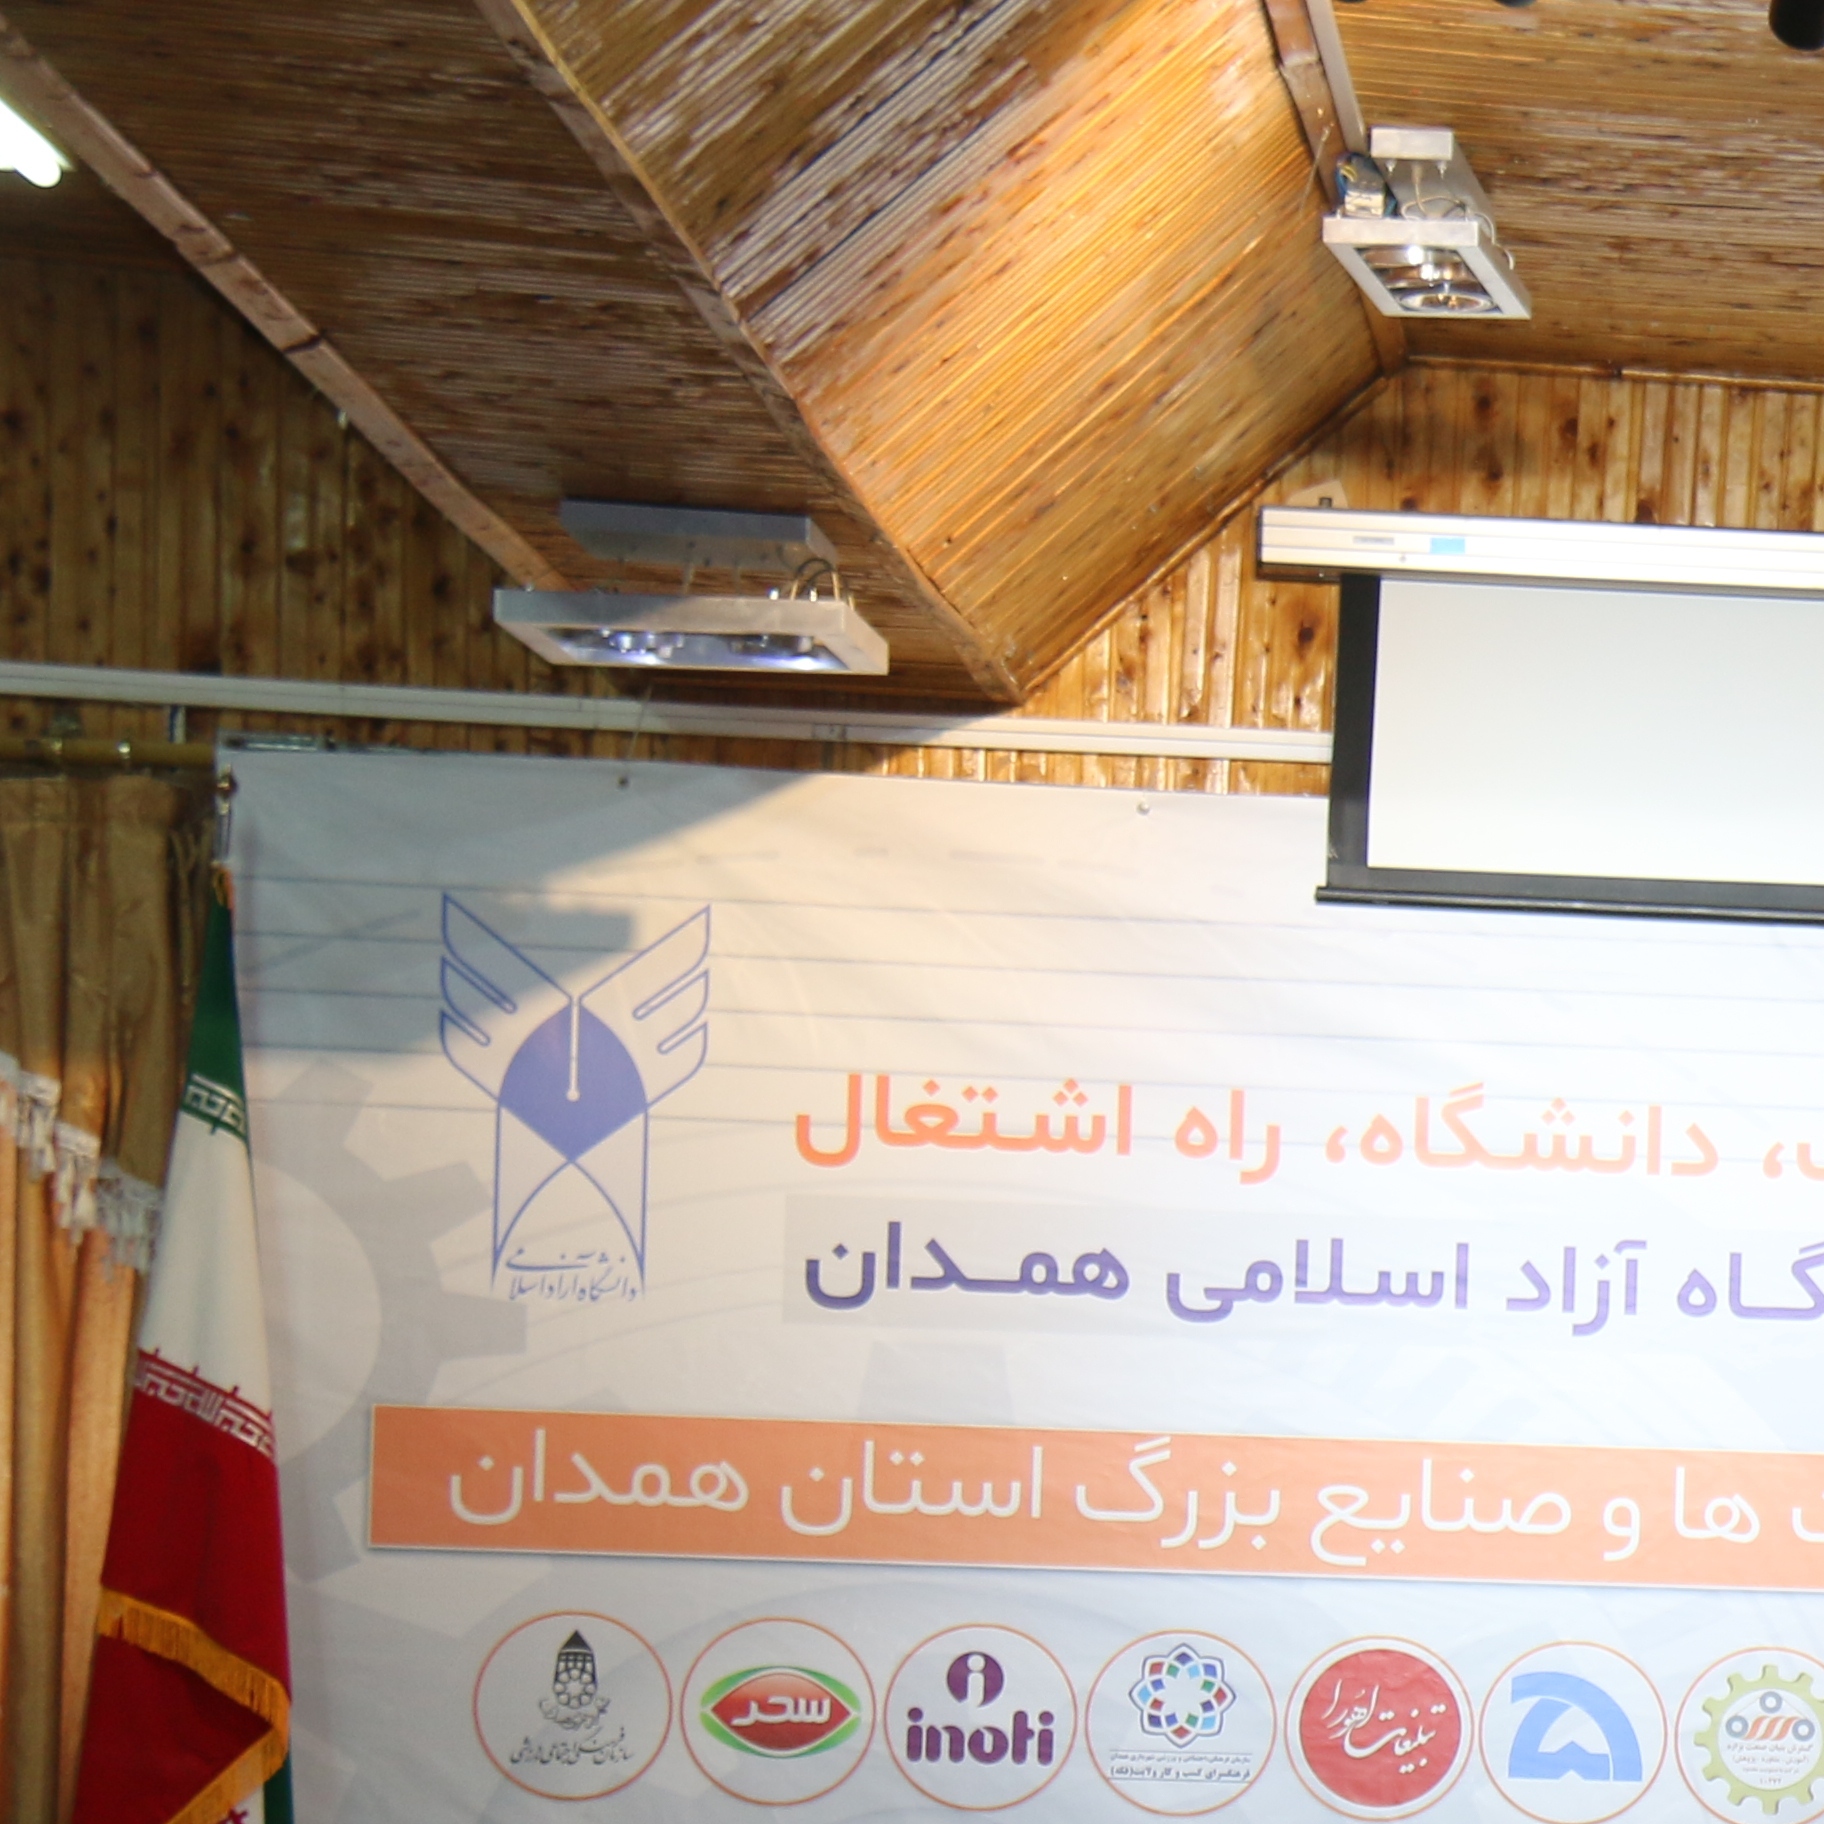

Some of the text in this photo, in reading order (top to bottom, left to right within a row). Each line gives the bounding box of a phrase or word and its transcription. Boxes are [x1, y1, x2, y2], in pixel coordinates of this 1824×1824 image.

[794, 1073, 1135, 1170] اشتغال
[1171, 1088, 1282, 1183] راه
[1325, 1081, 1720, 1179] دانشگاه،
[804, 1219, 1131, 1312] همدان
[1165, 1237, 1471, 1326] اسلامی
[1505, 1240, 1648, 1337] آزاد
[446, 1426, 750, 1528] همدان
[777, 1438, 1043, 1538] استان
[1074, 1433, 1283, 1553] بزرگ
[1308, 1457, 1572, 1568] صنایع
[1672, 1464, 1762, 1546] ها
[1600, 1497, 1644, 1564] و
[730, 1694, 832, 1728] سحر
[905, 1706, 1055, 1767] inoti
[1342, 1702, 1447, 1775] تبلیغات
